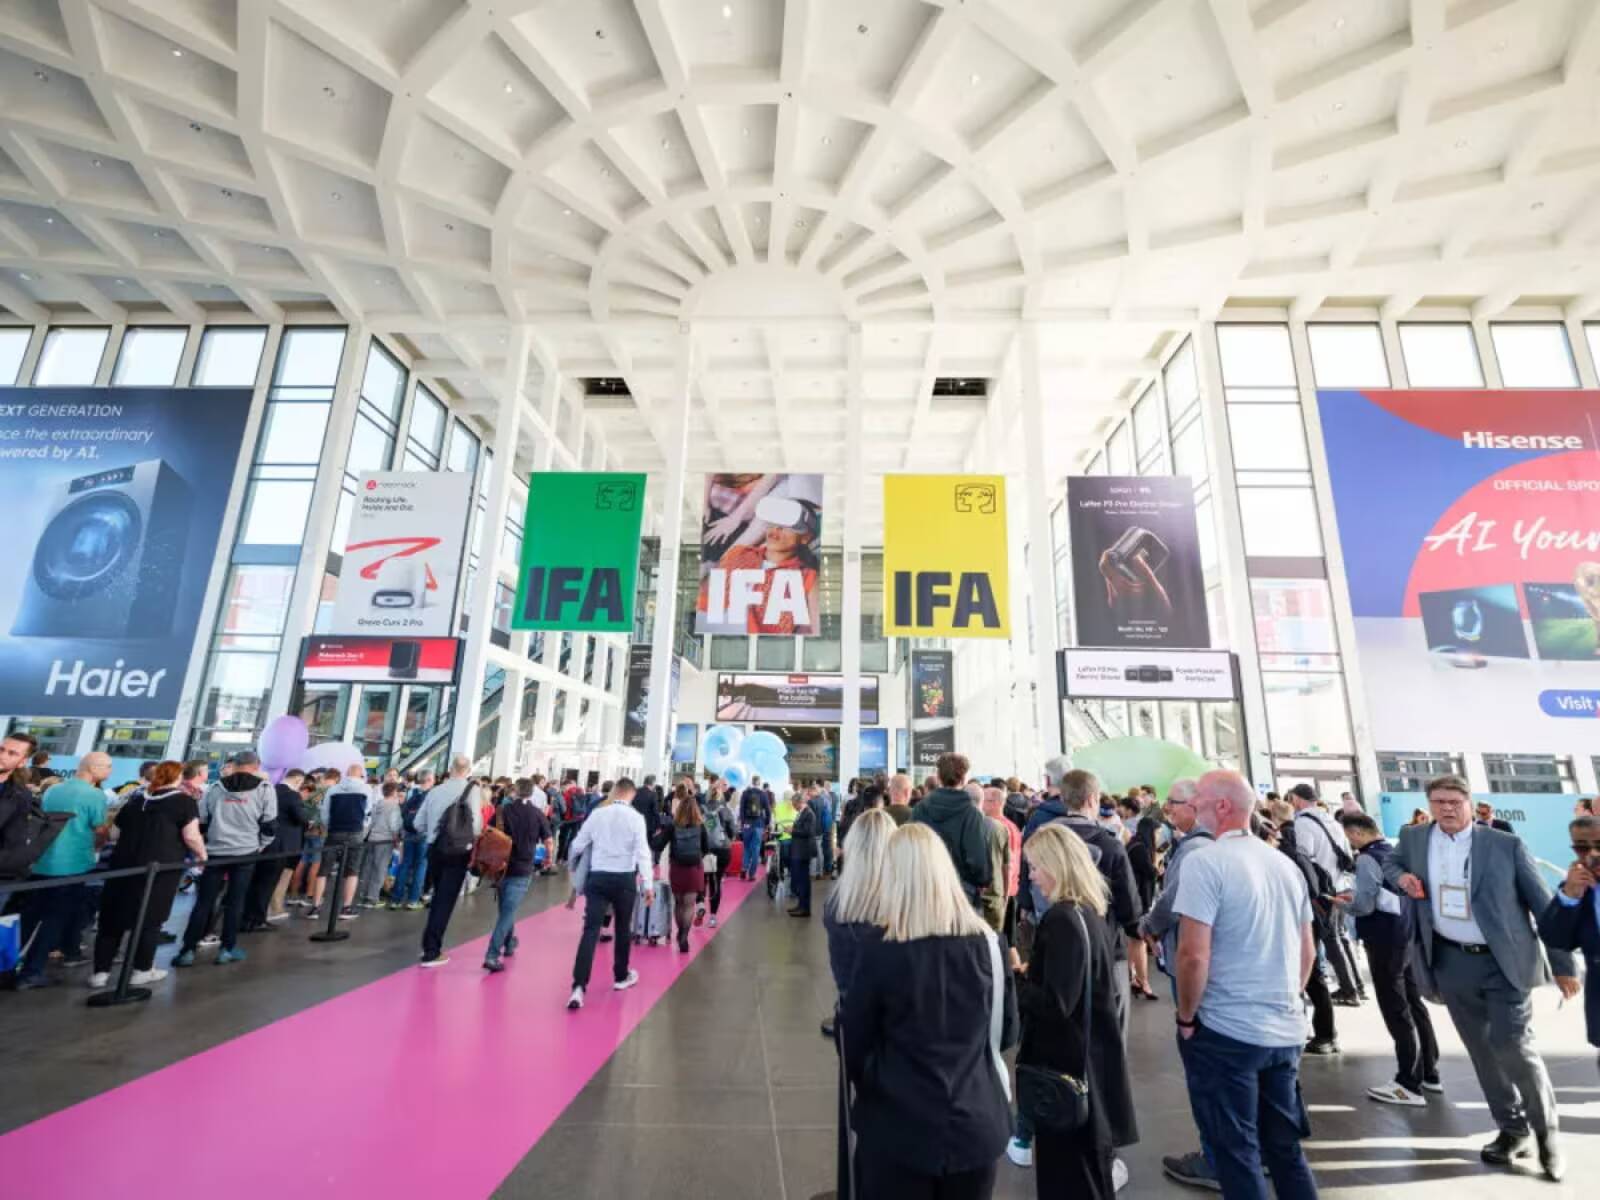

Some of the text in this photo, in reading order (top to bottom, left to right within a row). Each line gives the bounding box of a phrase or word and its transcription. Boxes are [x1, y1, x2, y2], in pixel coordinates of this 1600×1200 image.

[28, 404, 122, 417] GENERATION
[25, 427, 48, 440] the
[51, 428, 154, 445] extraordinary
[1463, 431, 1583, 449] Hisense
[52, 446, 72, 462] by
[1494, 480, 1564, 491] OFFICIAL
[1424, 512, 1498, 556] AI
[522, 567, 625, 622] IFA
[707, 568, 811, 625] IFA
[895, 571, 1000, 628] IFA
[45, 658, 167, 698] Haier
[1555, 696, 1594, 710] Visit
